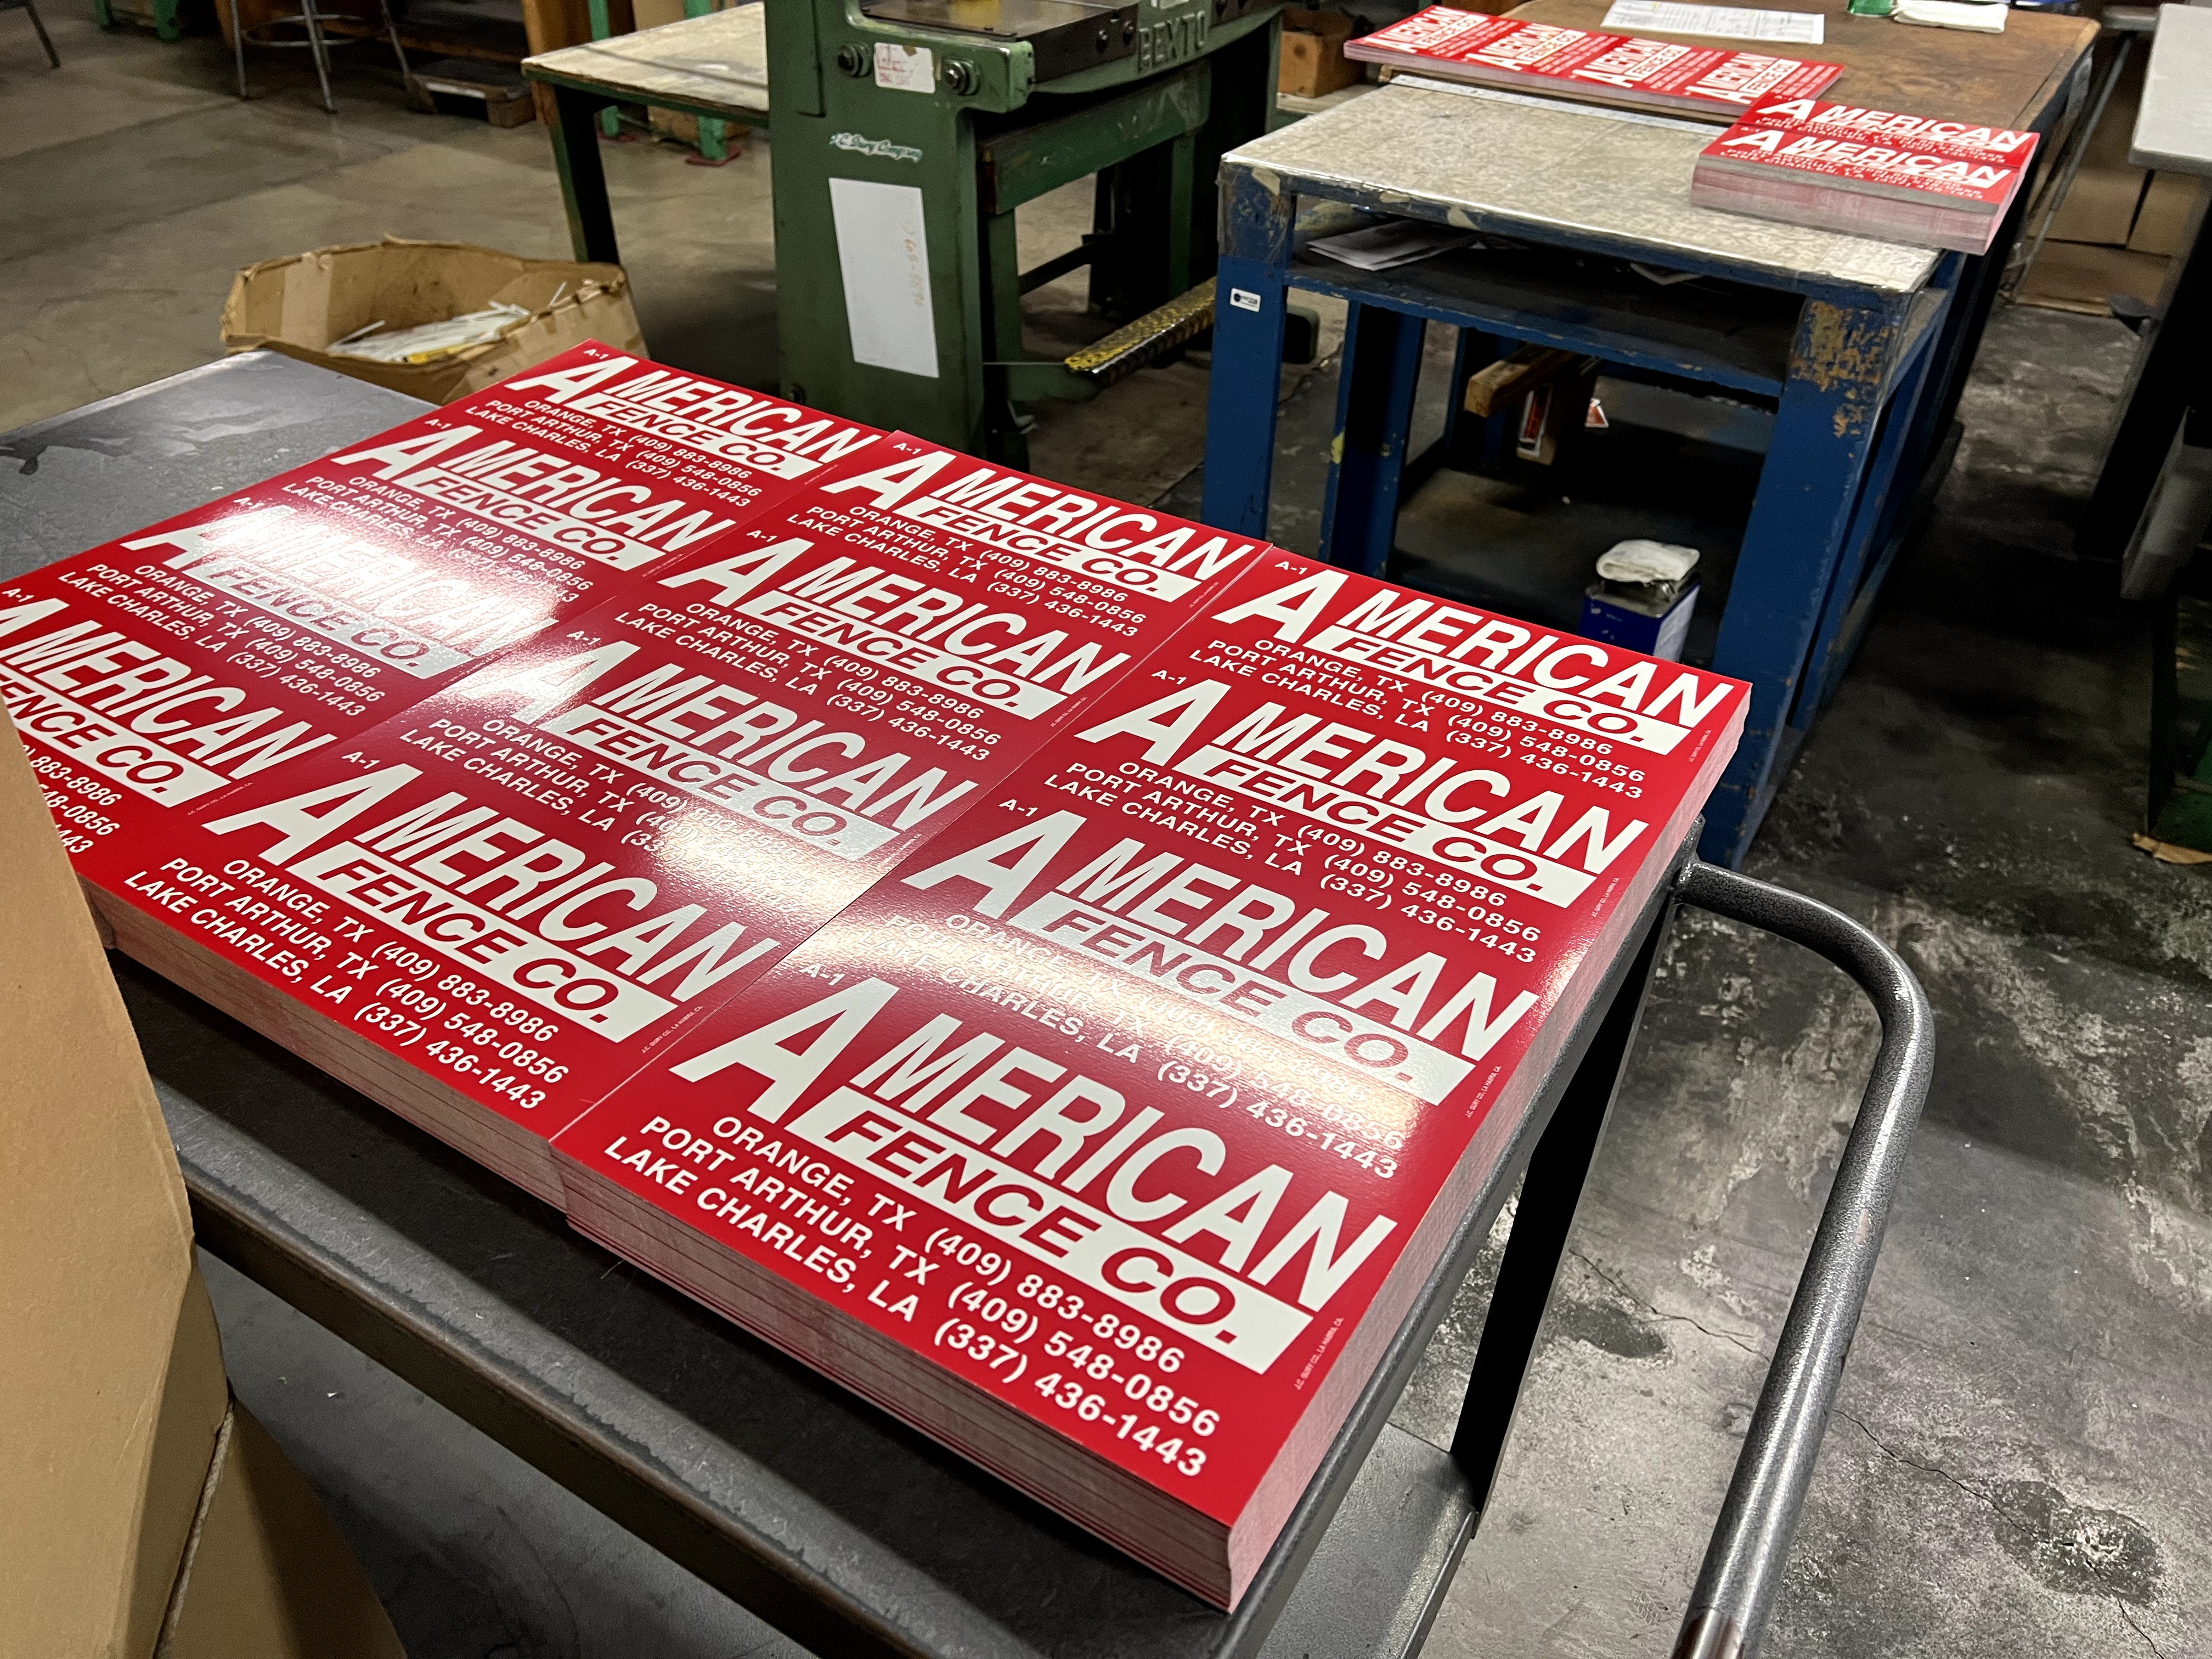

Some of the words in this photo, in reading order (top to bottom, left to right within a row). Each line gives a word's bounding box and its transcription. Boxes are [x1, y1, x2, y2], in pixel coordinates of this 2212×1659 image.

[1720, 129, 2011, 180] AMERICAN
[1756, 98, 2032, 145] AMERICAN
[504, 357, 883, 462] AMERICAN
[583, 349, 608, 359] A-1
[425, 419, 451, 428] A-1
[465, 407, 513, 424] LAKE
[512, 422, 590, 452] CHARLES,
[595, 449, 620, 461] LA
[625, 460, 671, 478] (337)
[673, 477, 749, 505] 436-1443
[485, 401, 534, 417] PORT
[531, 416, 602, 443] ARTHUR,
[608, 439, 634, 451] TX
[636, 450, 680, 468] (409)
[681, 465, 761, 495] 548-0856
[524, 401, 596, 428] ORANGE,
[601, 425, 627, 436] TX
[628, 435, 672, 452] (409)
[673, 449, 752, 477] 883-8986
[584, 400, 724, 444] FENCE
[719, 443, 785, 470] CO.
[893, 443, 921, 454] A-1
[329, 424, 737, 551] AMERICAN
[414, 476, 562, 529] FENCE
[554, 527, 625, 560] CO.
[747, 530, 776, 541] A-1
[816, 452, 1250, 583] AMERICAN
[2, 588, 33, 602] A-1
[916, 506, 1081, 561] FENCE
[1081, 558, 1156, 592] CO.
[1275, 561, 1307, 574] A-1
[55, 572, 112, 597] LAKE
[107, 595, 196, 639] CHARLES,
[196, 635, 228, 651] LA
[228, 651, 282, 676] (337)
[280, 675, 364, 715] 436-1443
[83, 564, 142, 588] PORT
[133, 588, 214, 625] ARTHUR,
[218, 622, 249, 637] TX
[246, 638, 298, 662] (409)
[296, 659, 383, 701] 548-0856
[133, 566, 215, 605] ORANGE,
[216, 601, 247, 616] TX
[245, 616, 296, 640] (409)
[294, 637, 380, 677] 883-8986
[206, 566, 364, 631] FENCE
[351, 629, 427, 668] CO.
[566, 630, 600, 646] A-1
[654, 535, 1135, 696] AMERICAN
[760, 602, 940, 669] FENCE
[936, 666, 1020, 708] CO.
[1209, 570, 1736, 729] AMERICAN
[0, 673, 117, 749] ENCE
[97, 746, 182, 793] CO.
[1151, 670, 1186, 684] A-1
[1188, 651, 1256, 676] LAKE
[1261, 674, 1383, 719] CHARLES,
[1395, 713, 1427, 731] LA
[1447, 730, 1511, 758] (337)
[1520, 754, 1641, 798] 436-1443
[1206, 641, 1276, 665] PORT
[1278, 664, 1387, 703] ARTHUR,
[1402, 698, 1435, 715] TX
[1448, 714, 1511, 741] (409)
[1520, 736, 1644, 781] 548-0856
[1254, 641, 1362, 680] ORANGE,
[1377, 675, 1409, 692] TX
[1422, 691, 1482, 716] (409)
[1491, 712, 1612, 754] 883-8986
[1331, 637, 1536, 704] FENCE
[1543, 699, 1643, 742] CO.
[30, 755, 122, 806] 883-8986
[342, 752, 380, 768] A-1
[454, 640, 977, 834] AMERICAN
[565, 718, 758, 800] FENCE
[752, 797, 843, 849] CO.
[1073, 678, 1651, 874] AMERICAN
[998, 799, 1037, 816] A-1
[1203, 759, 1426, 842] FENCE
[1432, 837, 1542, 891] CO.
[199, 759, 778, 1006] AMERICAN
[900, 806, 1542, 1061] AMERICAN
[122, 873, 196, 914] LAKE
[190, 910, 308, 981] CHARLES,
[311, 975, 352, 1002] LA
[354, 1002, 426, 1045] (337)
[426, 1041, 542, 1111] 436-1443
[159, 860, 234, 898] PORT
[224, 896, 331, 959] ARTHUR,
[337, 951, 379, 978] TX
[376, 978, 447, 1019] (409)
[444, 1012, 566, 1085] 548-0856
[223, 860, 330, 923] ORANGE,
[334, 916, 374, 941] TX
[371, 941, 440, 980] (409)
[438, 974, 557, 1042] 883-8986
[317, 858, 527, 963] FENCE
[514, 958, 616, 1025] CO.
[799, 964, 843, 986] A-1
[1041, 909, 1286, 1018] FENCE
[1291, 1012, 1412, 1082] CO.
[667, 972, 1395, 1314] AMERICAN
[639, 1118, 735, 1171] PORT
[730, 1168, 872, 1256] ARTHUR,
[890, 1244, 939, 1284] TX
[949, 1281, 1037, 1342] (409)
[1045, 1331, 1216, 1438] 548-0856
[713, 1117, 854, 1204] ORANGE,
[868, 1193, 916, 1229] TX
[926, 1227, 1011, 1284] (409)
[1018, 1274, 1182, 1373] 883-8986
[825, 1110, 1101, 1257] FENCE
[1101, 1248, 1234, 1345] CO.
[603, 1139, 697, 1195] LAKE
[697, 1189, 855, 1291] CHARLES,
[868, 1279, 918, 1320] LA
[935, 1318, 1026, 1383] (337)
[1035, 1374, 1203, 1480] 436-1443
